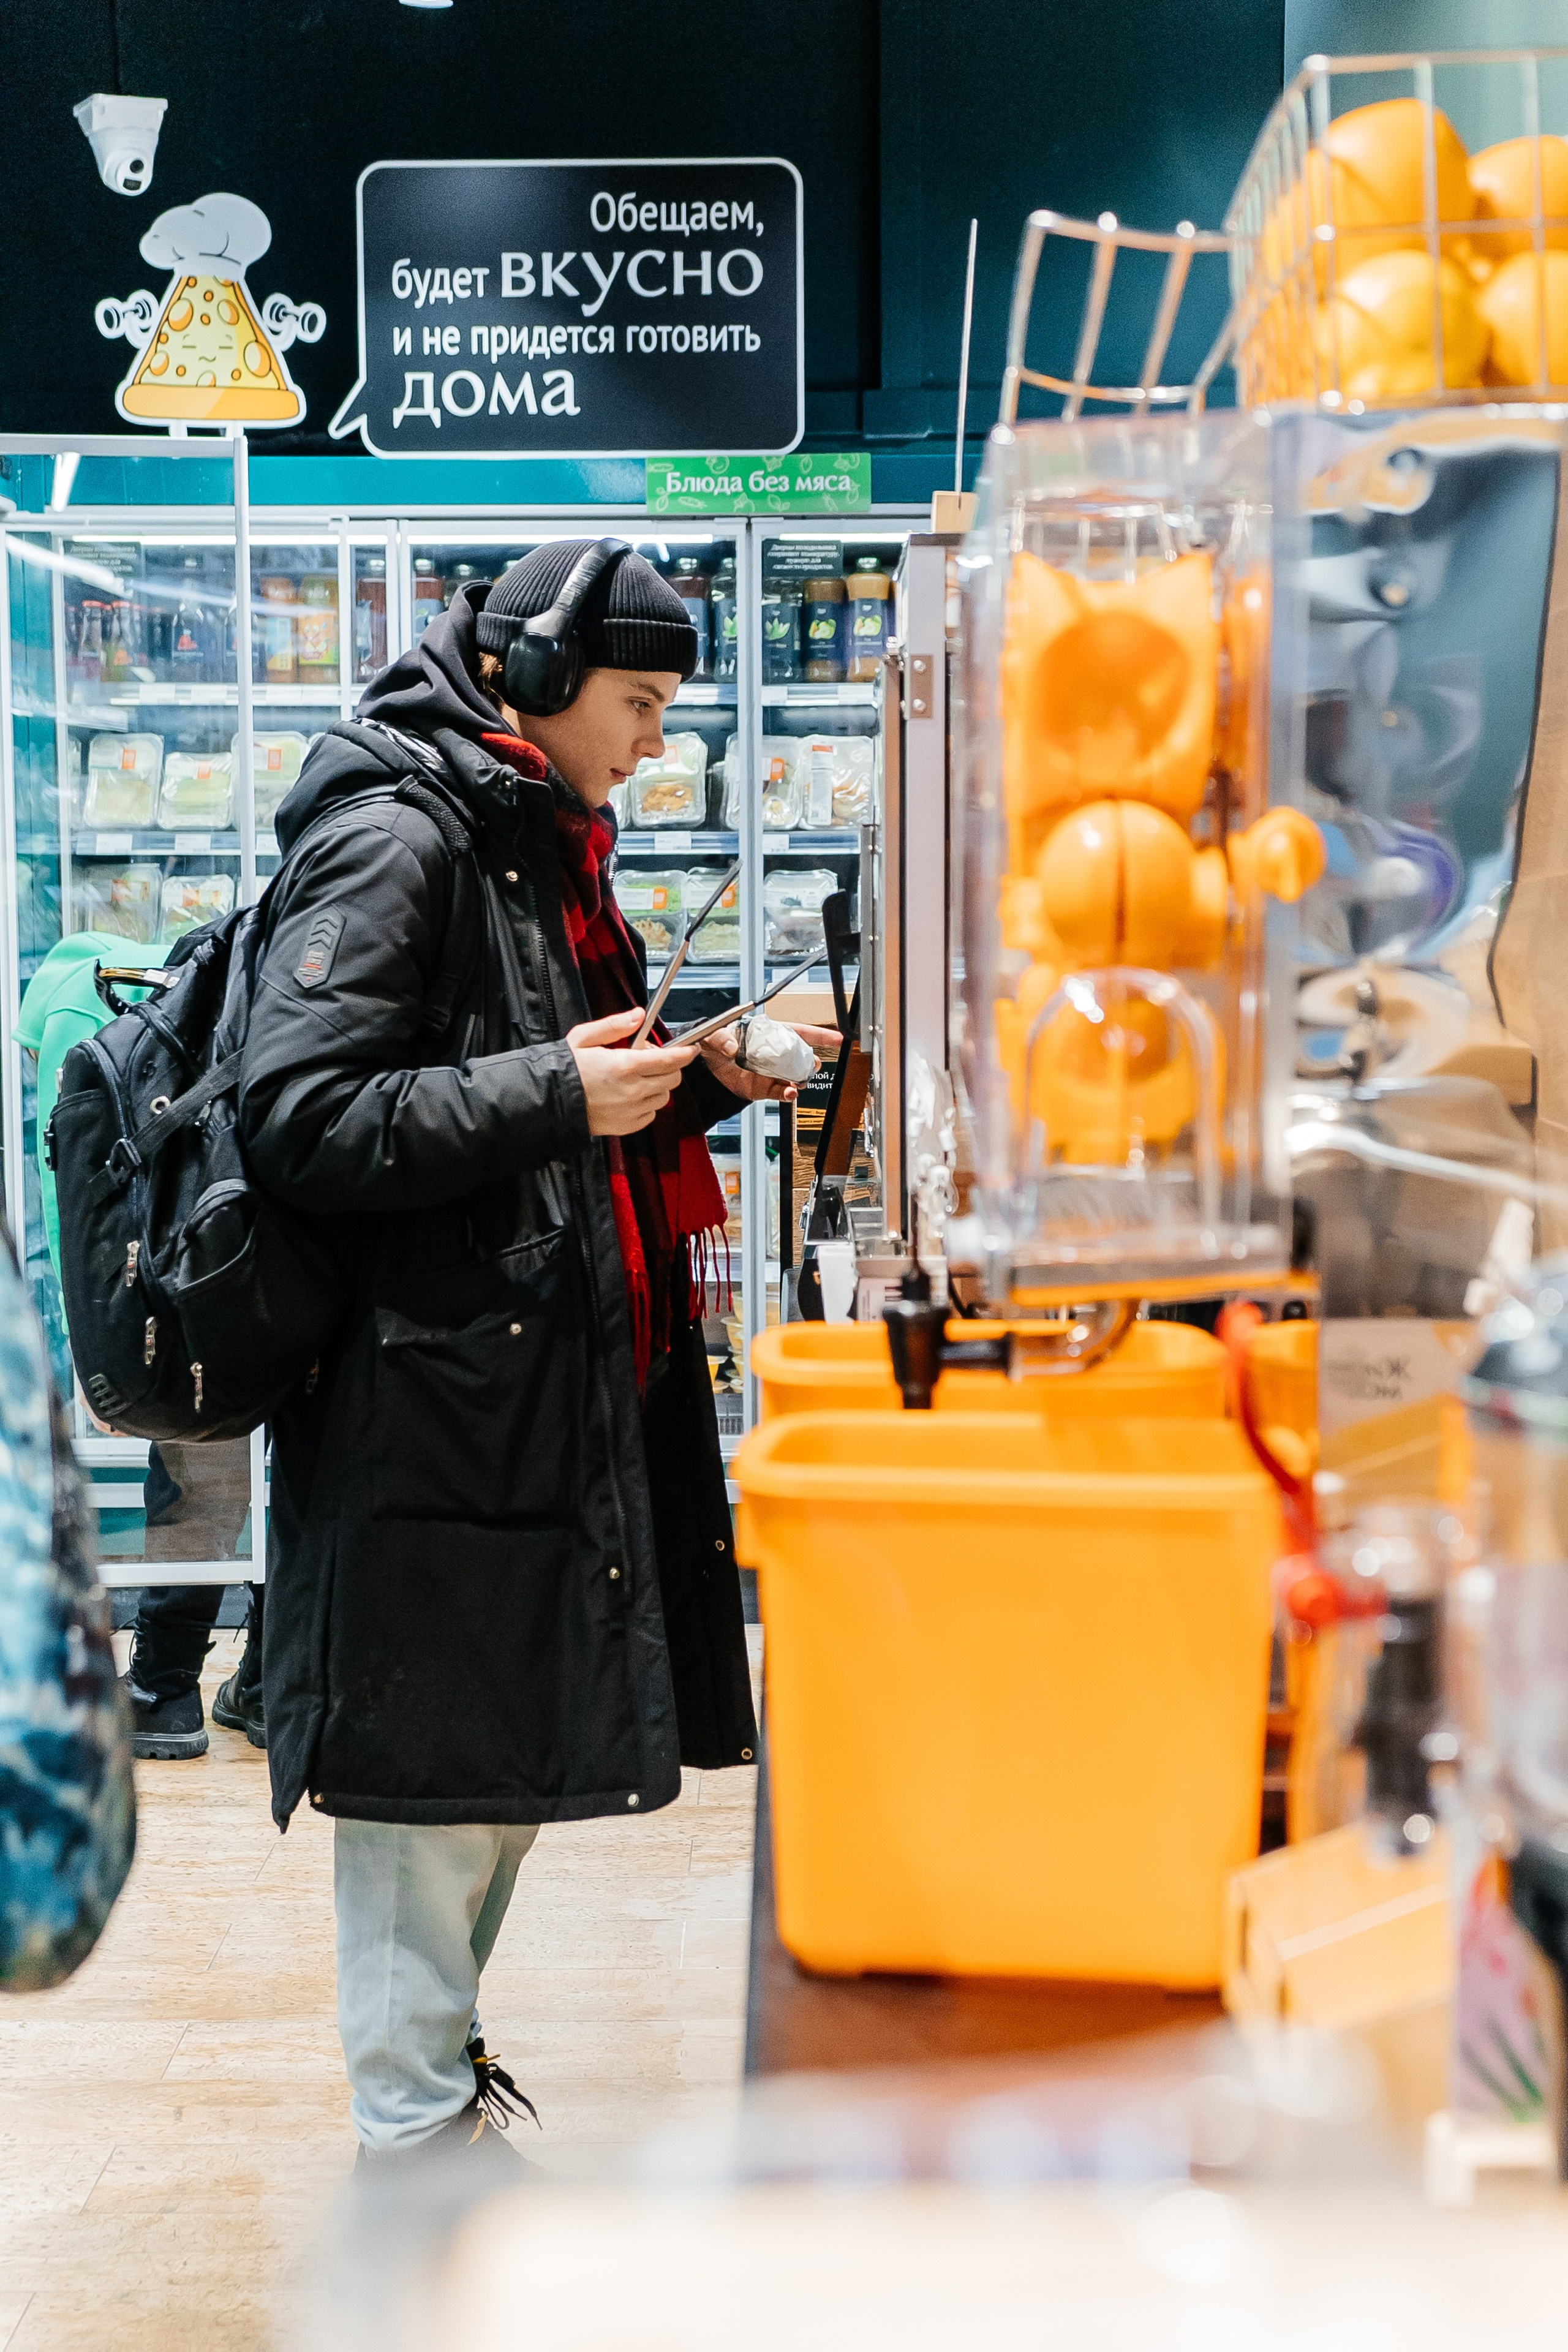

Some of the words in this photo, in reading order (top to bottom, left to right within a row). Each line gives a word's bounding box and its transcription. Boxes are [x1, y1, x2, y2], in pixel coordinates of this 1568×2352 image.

[590, 192, 764, 236] Обещаем,
[391, 258, 490, 309] будет
[393, 326, 412, 356] и
[422, 325, 461, 356] не
[470, 325, 614, 364] придется
[626, 325, 761, 353] готовить
[392, 369, 581, 429] дома
[666, 472, 743, 496] Блюда
[748, 470, 790, 492] без
[796, 475, 851, 491] мяса
